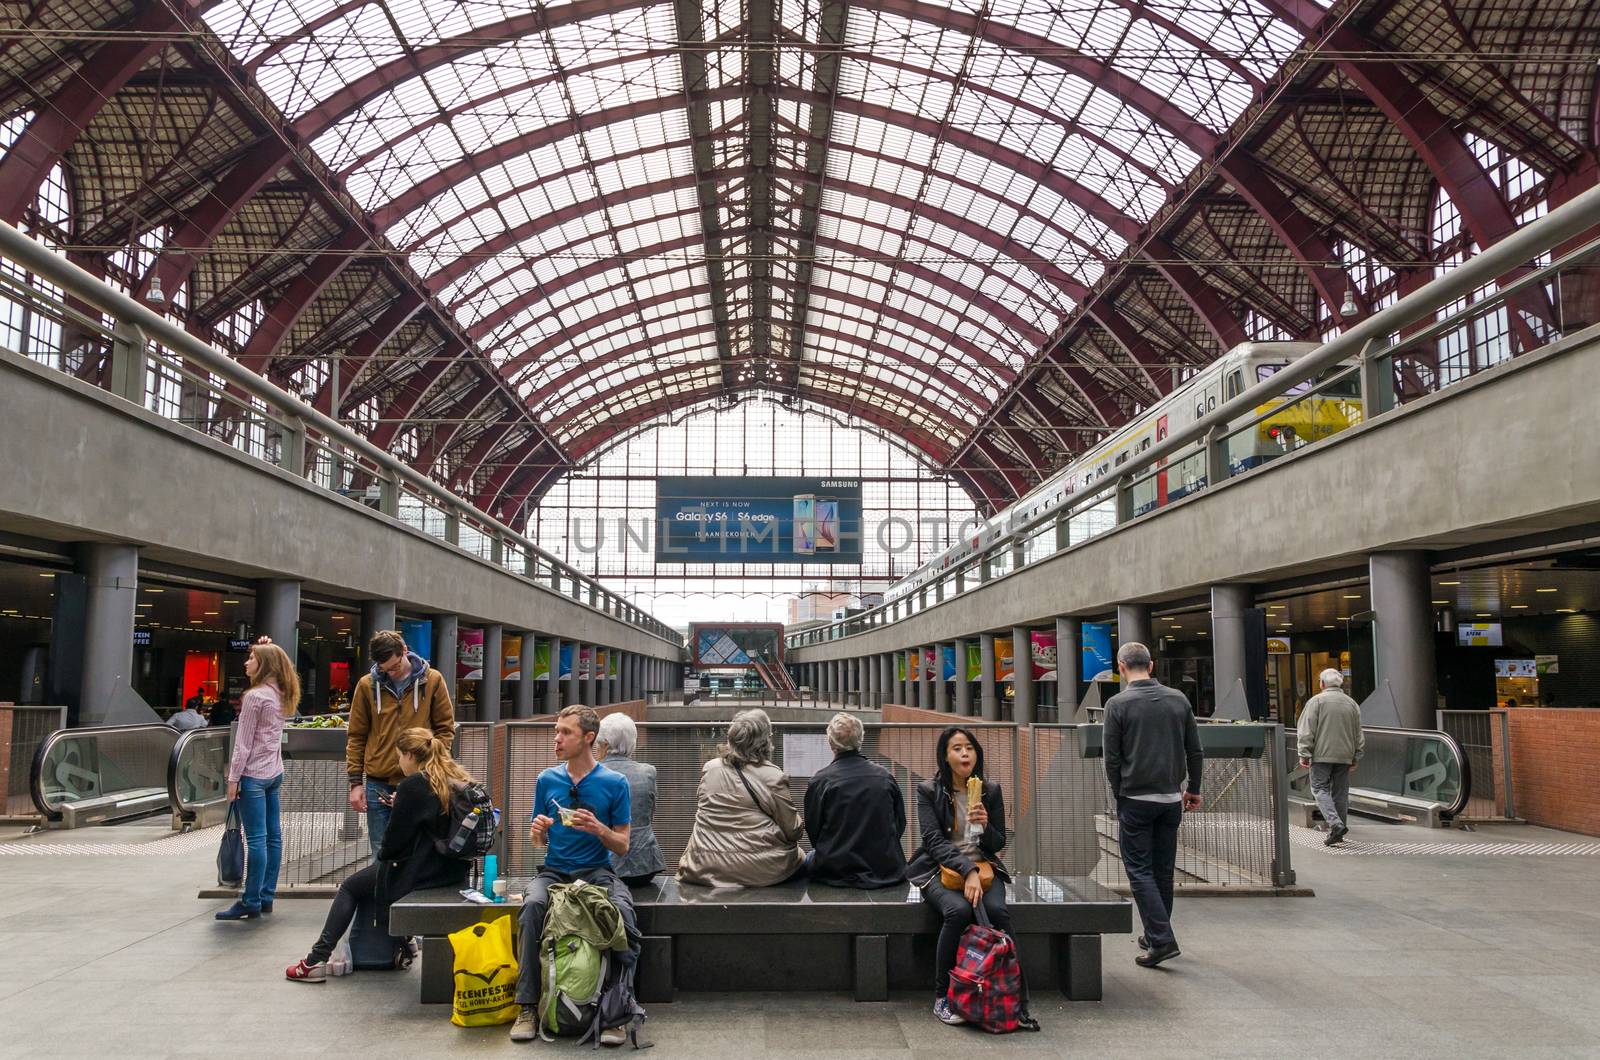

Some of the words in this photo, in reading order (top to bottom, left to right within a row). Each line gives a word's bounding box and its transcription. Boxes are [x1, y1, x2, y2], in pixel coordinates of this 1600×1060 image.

[676, 512, 714, 523] Galaxy
[715, 512, 728, 521] S6
[737, 512, 750, 521] S6
[751, 513, 775, 523] edge
